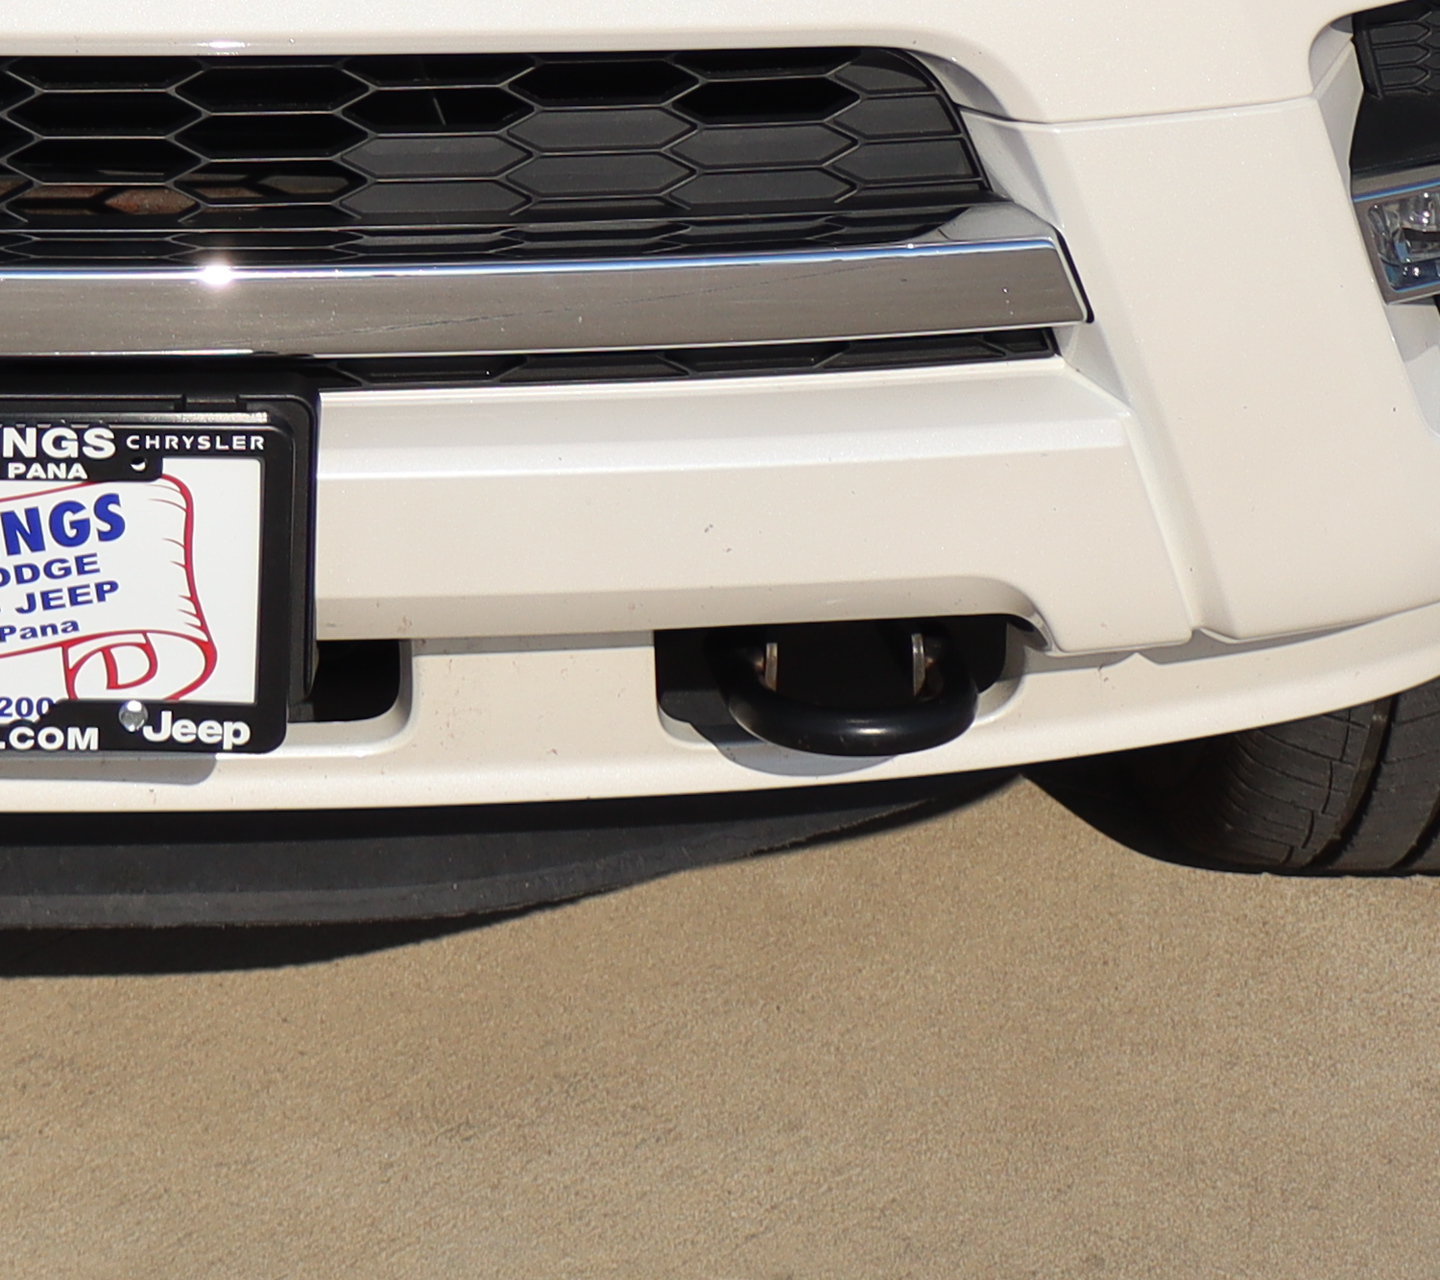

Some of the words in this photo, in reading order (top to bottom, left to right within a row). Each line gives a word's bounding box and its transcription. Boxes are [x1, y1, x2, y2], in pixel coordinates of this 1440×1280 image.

[126, 434, 265, 451] CHRYSLER
[8, 461, 88, 480] PANA
[15, 580, 120, 615] JEEP
[142, 711, 251, 751] Jeep
